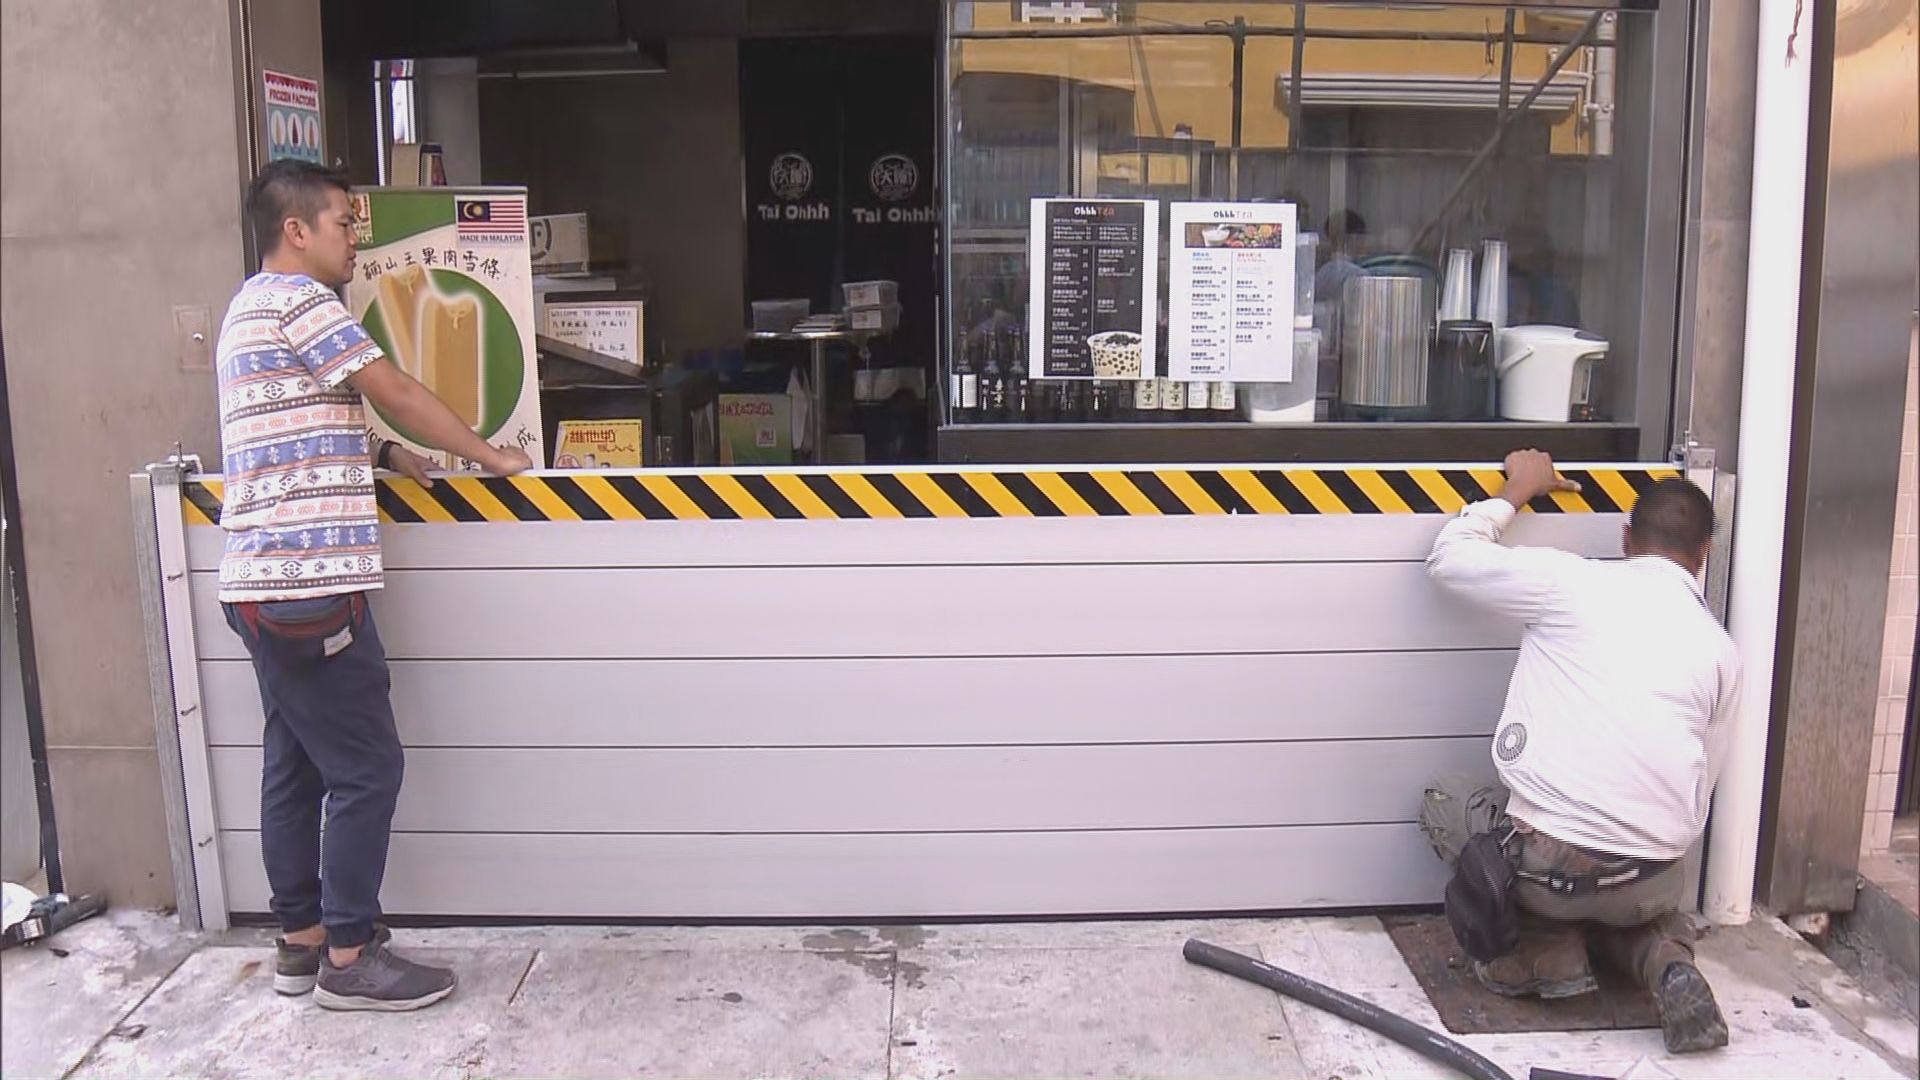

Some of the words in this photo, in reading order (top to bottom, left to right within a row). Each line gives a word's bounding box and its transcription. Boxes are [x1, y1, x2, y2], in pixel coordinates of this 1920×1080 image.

[758, 204, 780, 220] Tai
[785, 202, 830, 220] Ohhh
[852, 207, 881, 224] Tai
